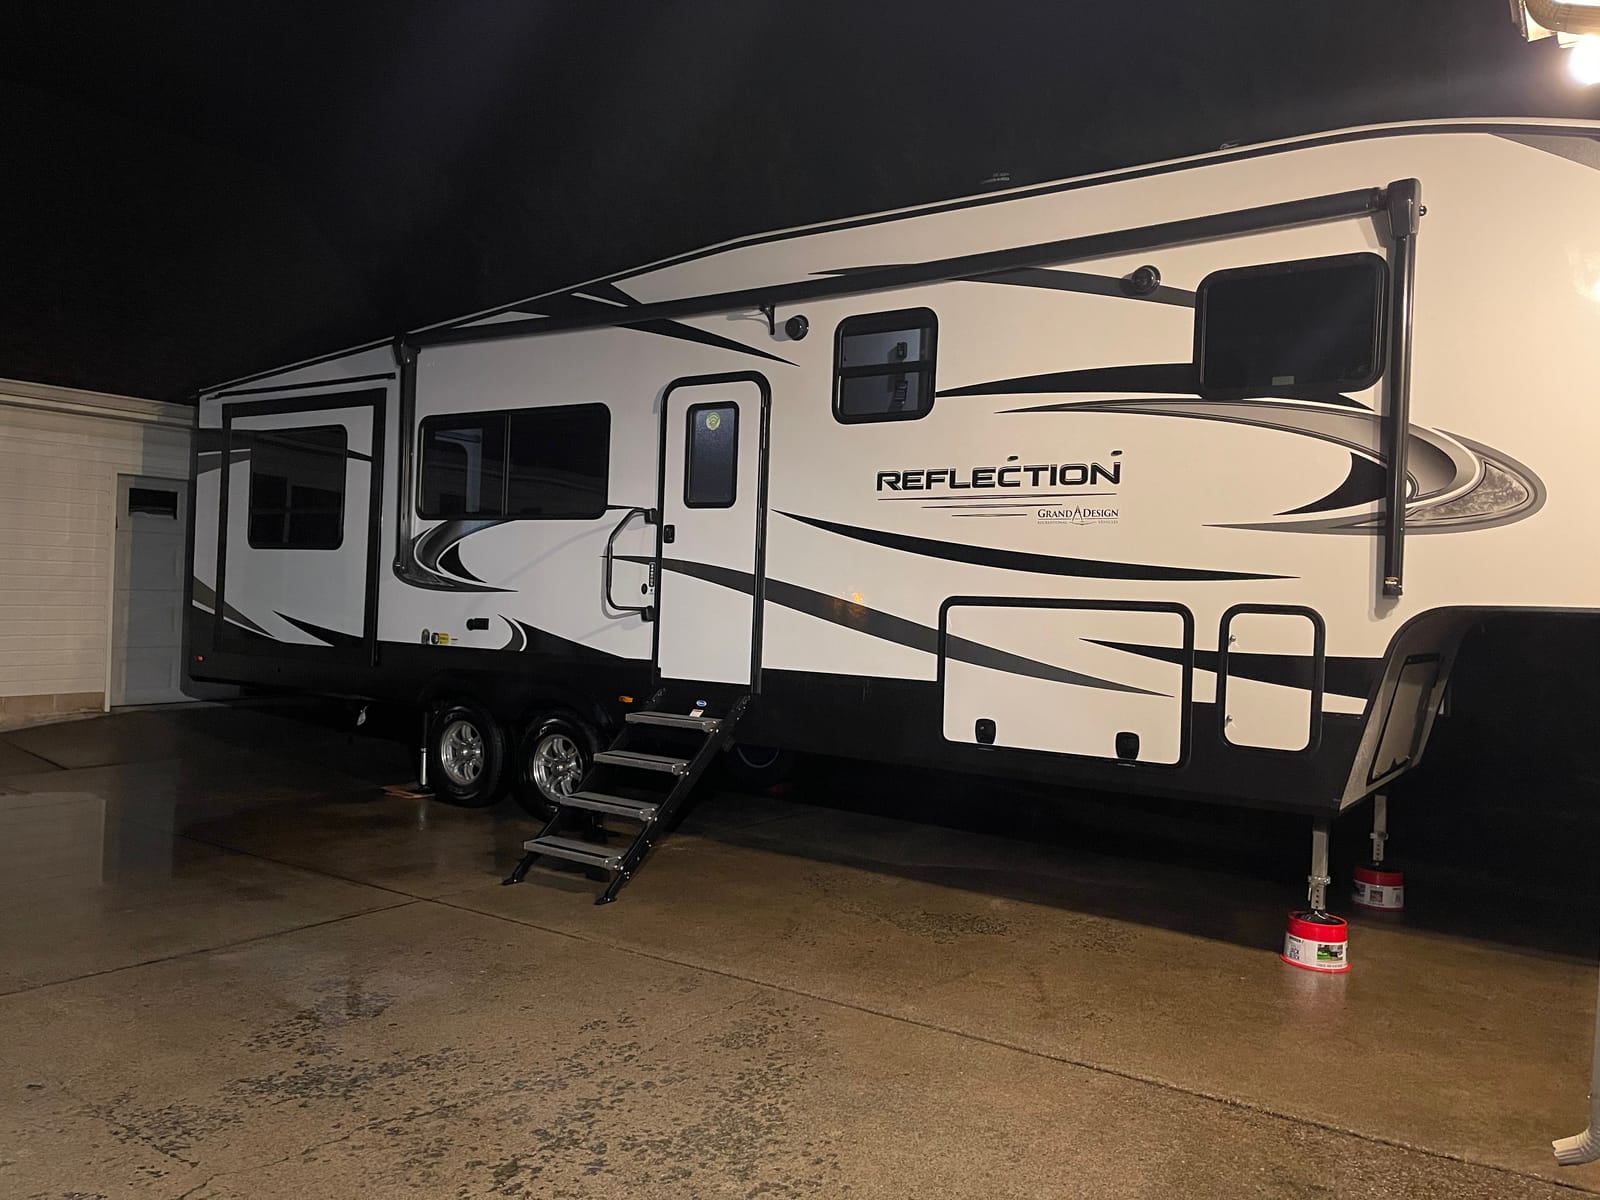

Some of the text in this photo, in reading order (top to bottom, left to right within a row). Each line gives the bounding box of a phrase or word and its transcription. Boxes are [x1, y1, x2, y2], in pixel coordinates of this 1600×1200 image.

[876, 460, 1121, 492] REFLECTION
[1037, 508, 1119, 518] GRAND DESIGN
